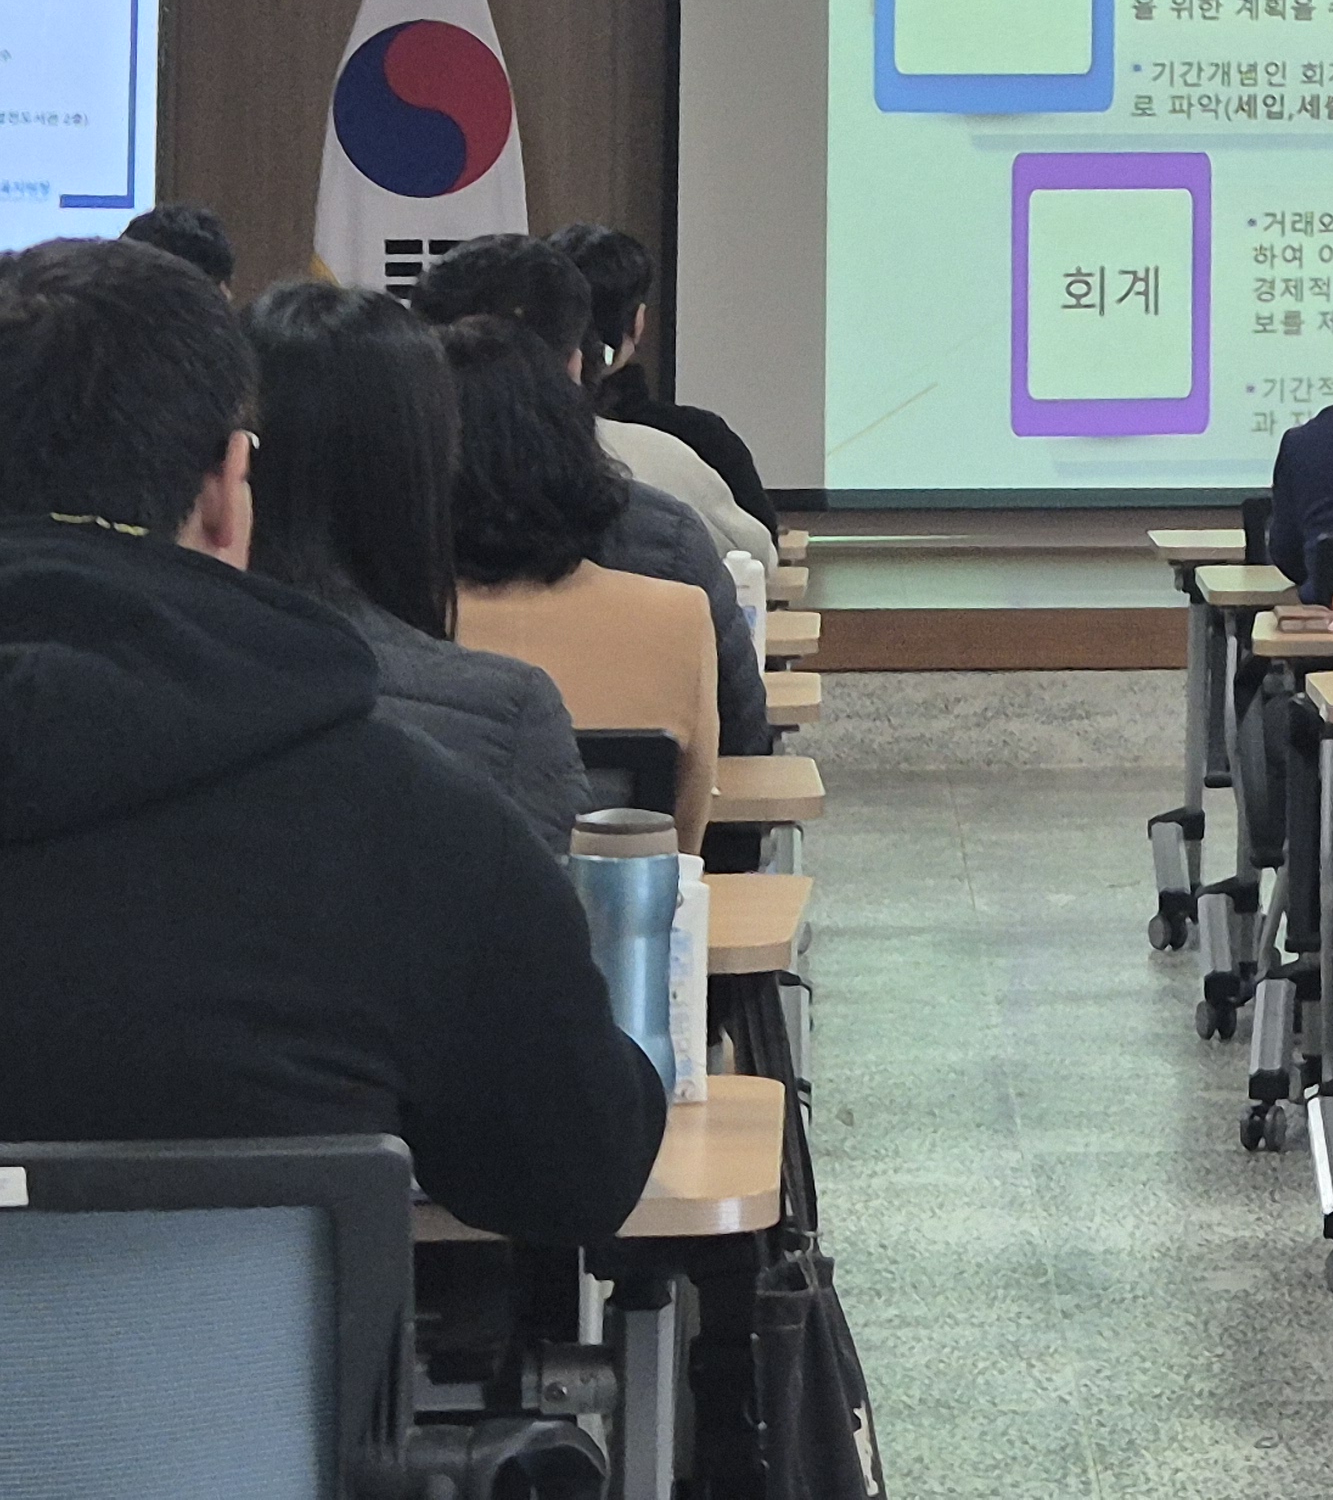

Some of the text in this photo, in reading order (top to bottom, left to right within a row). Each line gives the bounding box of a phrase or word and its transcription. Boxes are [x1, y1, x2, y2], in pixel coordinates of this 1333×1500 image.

[1151, 60, 1288, 88] 기간개념인
[1131, 93, 1157, 118] 로
[1253, 243, 1304, 270] 하여
[1060, 262, 1164, 319] 회계
[1253, 276, 1332, 302] 경제적
[1252, 310, 1306, 336] 보를
[1250, 411, 1277, 436] 과
